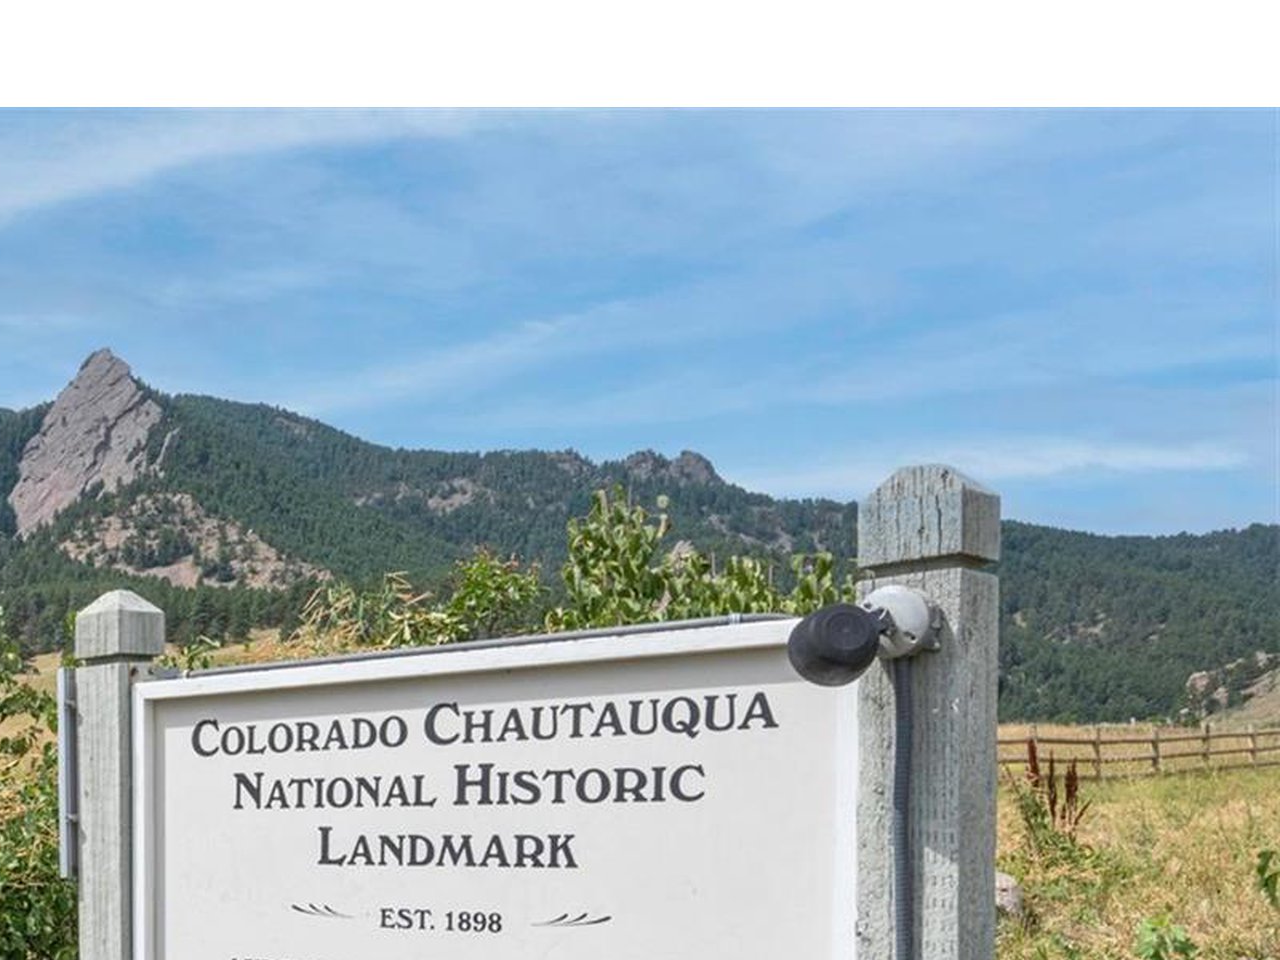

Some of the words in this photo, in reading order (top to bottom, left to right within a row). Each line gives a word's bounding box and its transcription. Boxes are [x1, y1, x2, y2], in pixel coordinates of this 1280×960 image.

[191, 715, 409, 757] COLORADO
[424, 691, 780, 746] CHAUTAUQUA
[233, 772, 437, 810] NATIONAL
[453, 763, 705, 806] HISTORIC
[317, 826, 579, 869] LANDMARK
[380, 908, 435, 930] EST.
[446, 911, 503, 934] 1898
